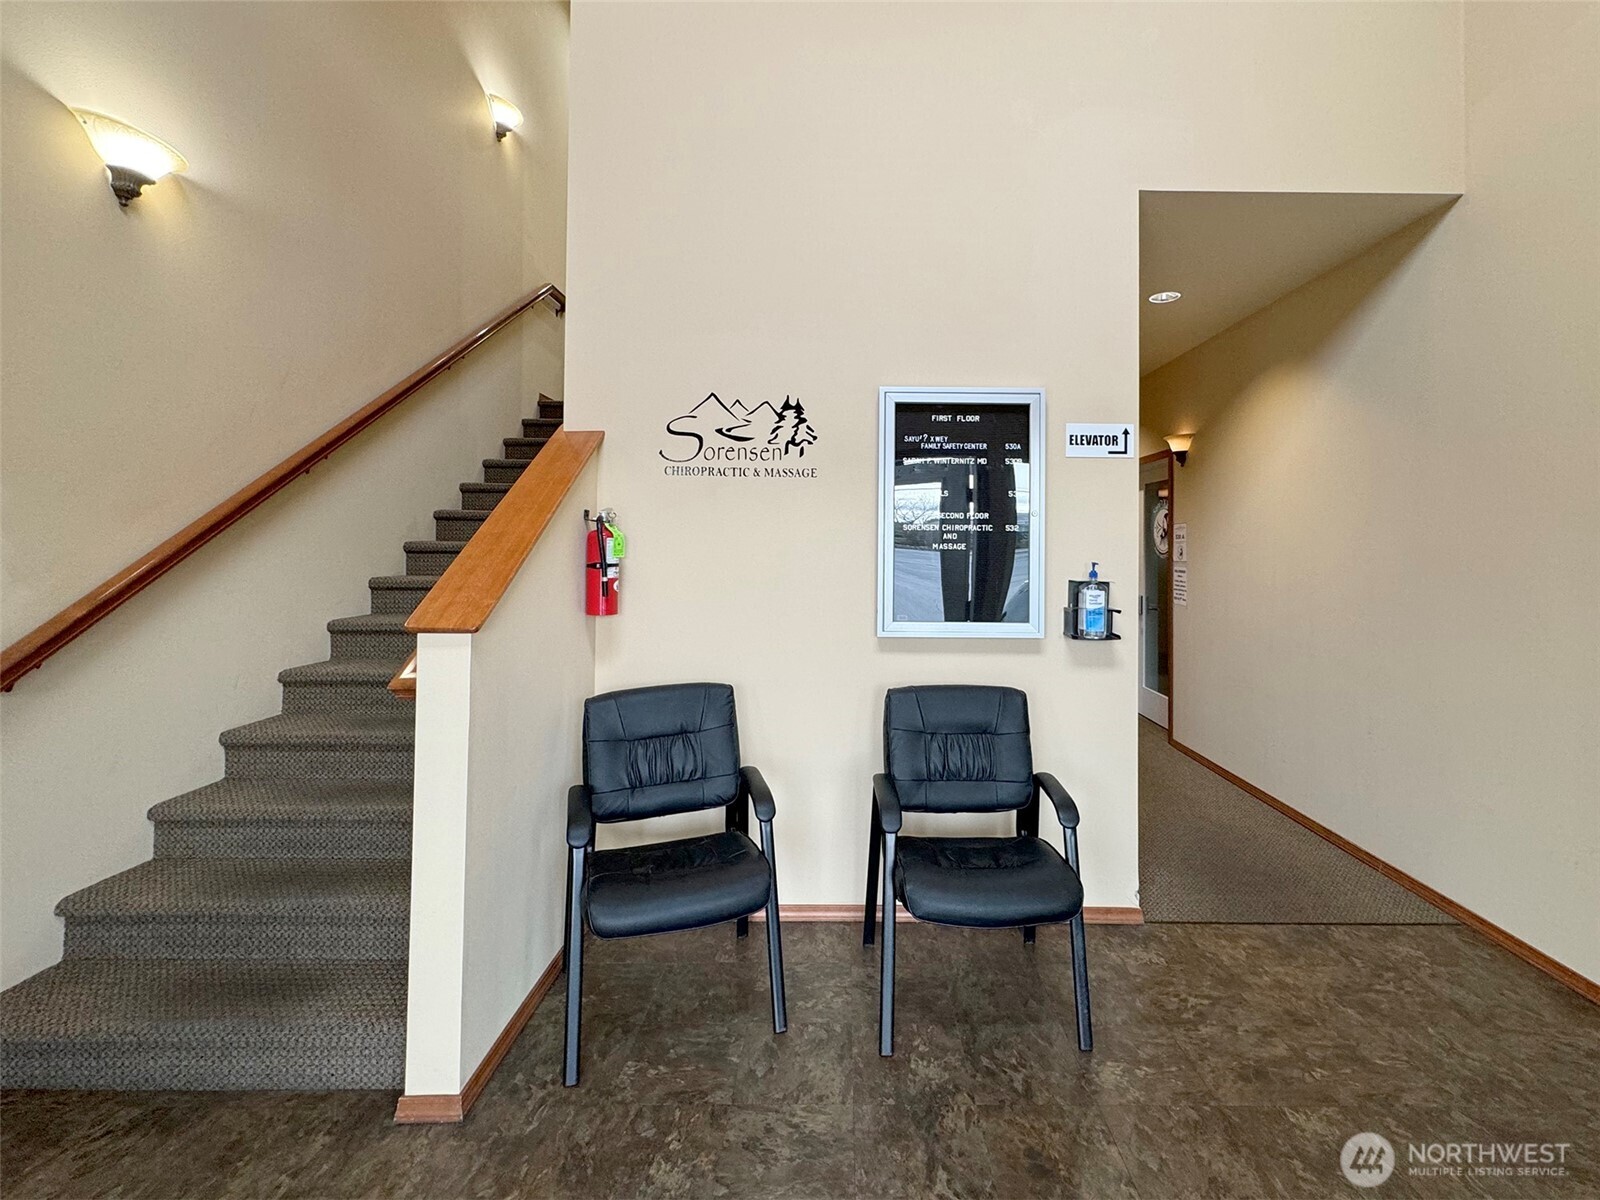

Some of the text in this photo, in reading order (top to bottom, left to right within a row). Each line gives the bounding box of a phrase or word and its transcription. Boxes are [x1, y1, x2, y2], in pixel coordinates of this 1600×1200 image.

[659, 415, 782, 462] Sorensen
[1069, 434, 1119, 446] ELEVATOR
[920, 442, 941, 450] FAMILY
[942, 442, 963, 450] SAFETY
[963, 442, 988, 450] CENTER
[976, 457, 988, 465] MD
[664, 465, 818, 478] CHIROPRACTIC & MASSAGE
[902, 524, 939, 532] SORENSEN
[932, 543, 967, 551] MASSAGE
